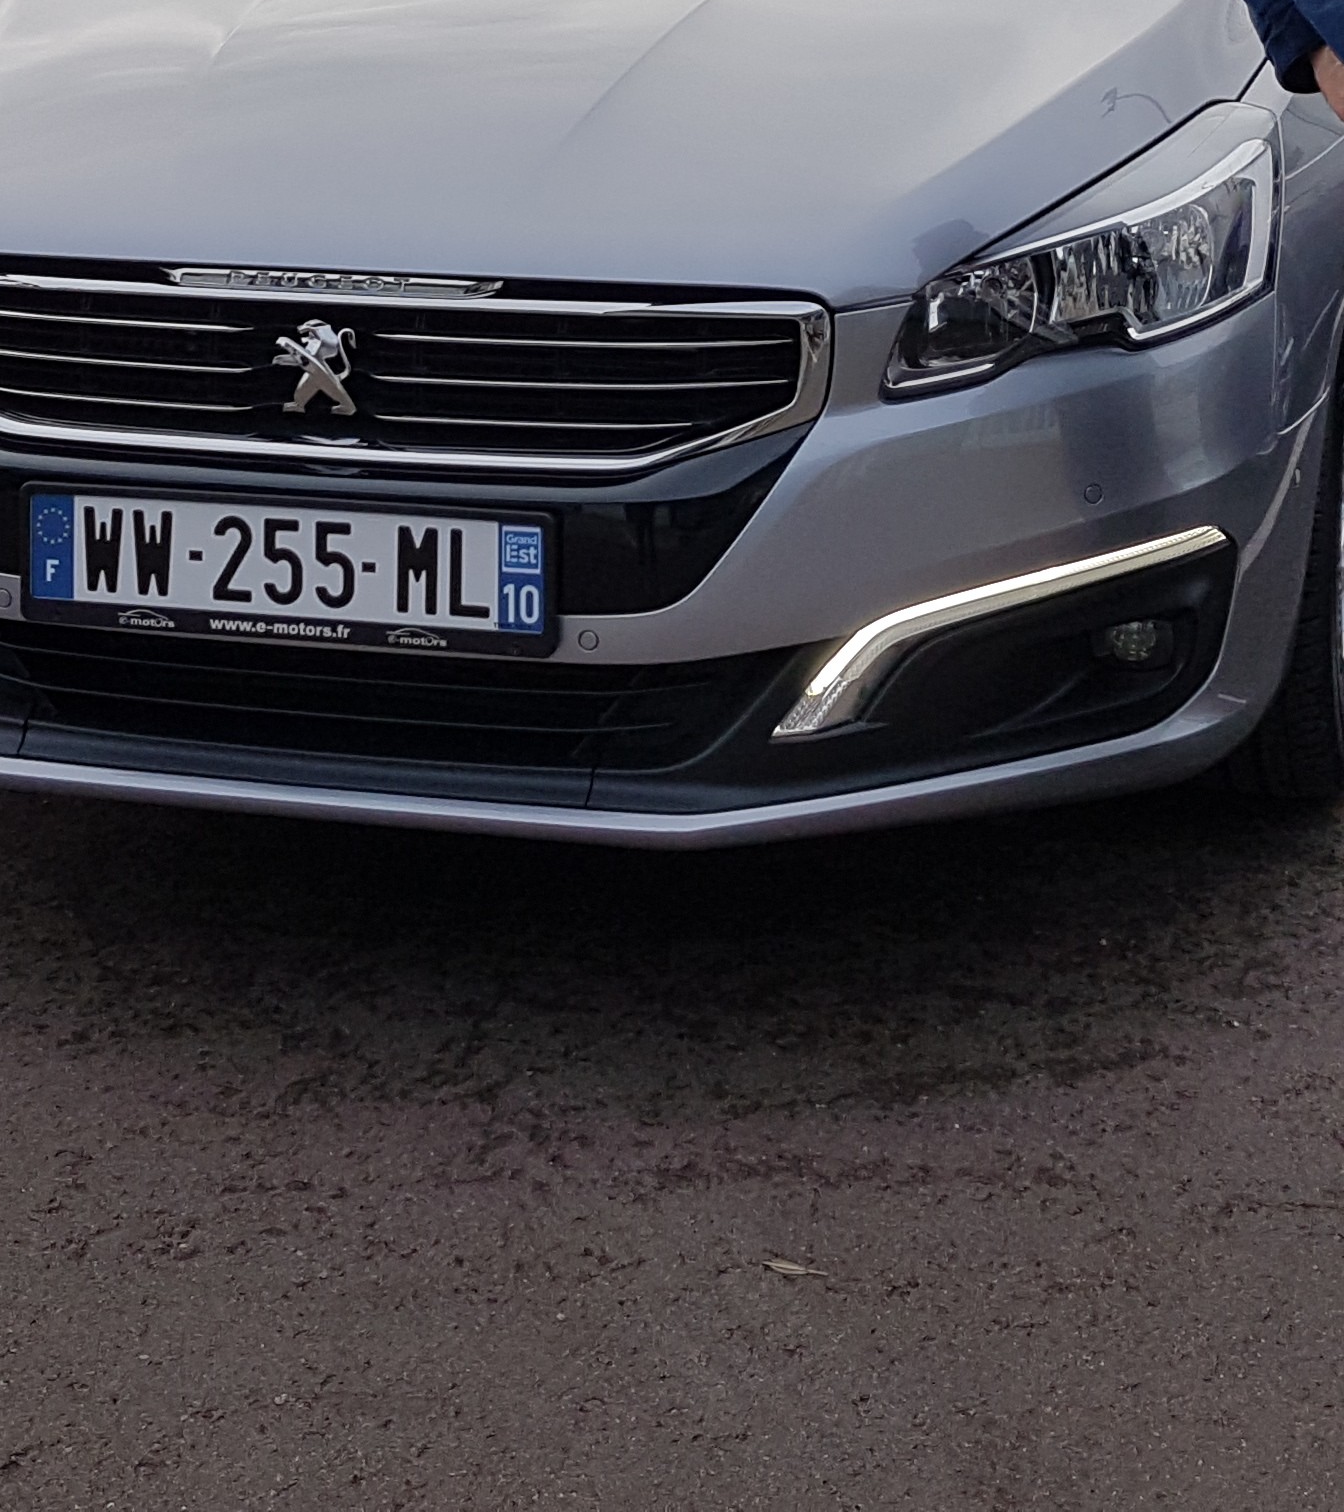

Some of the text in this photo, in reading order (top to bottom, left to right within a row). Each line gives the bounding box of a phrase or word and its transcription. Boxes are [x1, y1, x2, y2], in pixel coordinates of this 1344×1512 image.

[228, 271, 410, 291] PEUGEOT
[506, 534, 537, 544] Grand
[83, 506, 490, 618] WW-255-ML
[506, 544, 537, 564] Est
[46, 559, 59, 581] F
[503, 584, 539, 624] 10
[210, 618, 350, 639] www.e-motors.fr
